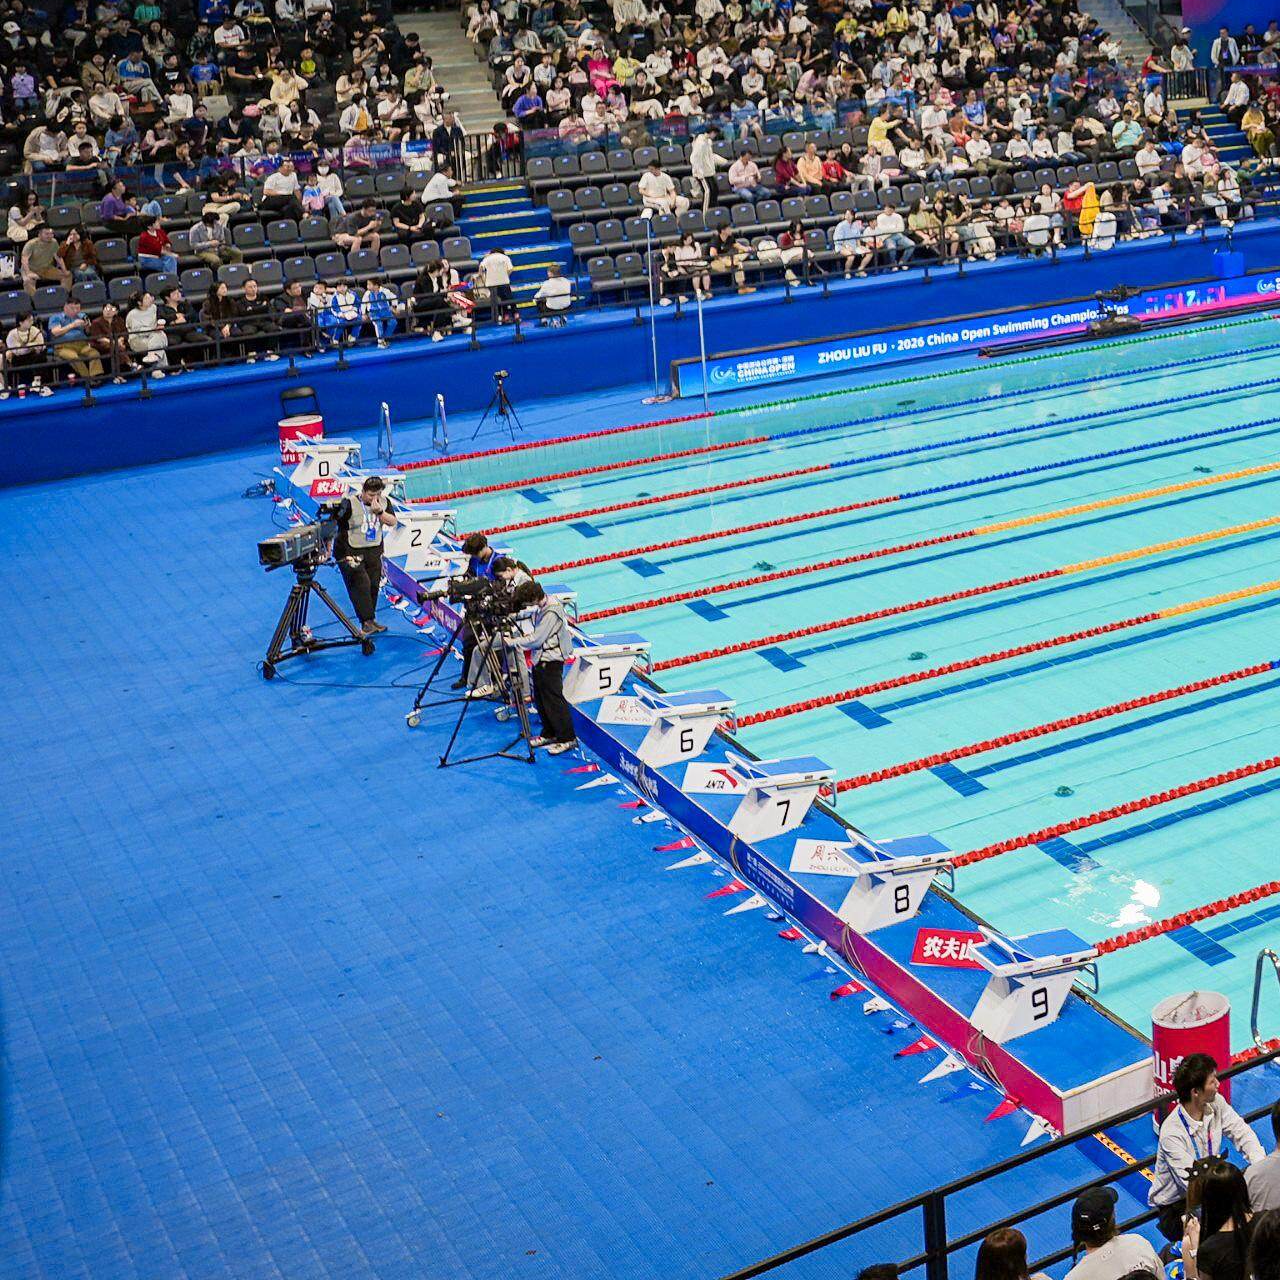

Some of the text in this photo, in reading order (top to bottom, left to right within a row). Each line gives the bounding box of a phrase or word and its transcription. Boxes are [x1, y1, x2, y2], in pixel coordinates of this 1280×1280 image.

[817, 303, 1130, 365] ZHOU LIU FU 2026 China Open Swimming Champiops
[737, 365, 769, 378] CHINA
[318, 460, 330, 477] 0
[410, 528, 422, 548] 2
[598, 666, 612, 690] 5
[680, 728, 694, 753] 6
[705, 778, 726, 790] ANTA
[775, 799, 791, 826] 7
[894, 883, 910, 914] 8
[1031, 986, 1049, 1021] 9
